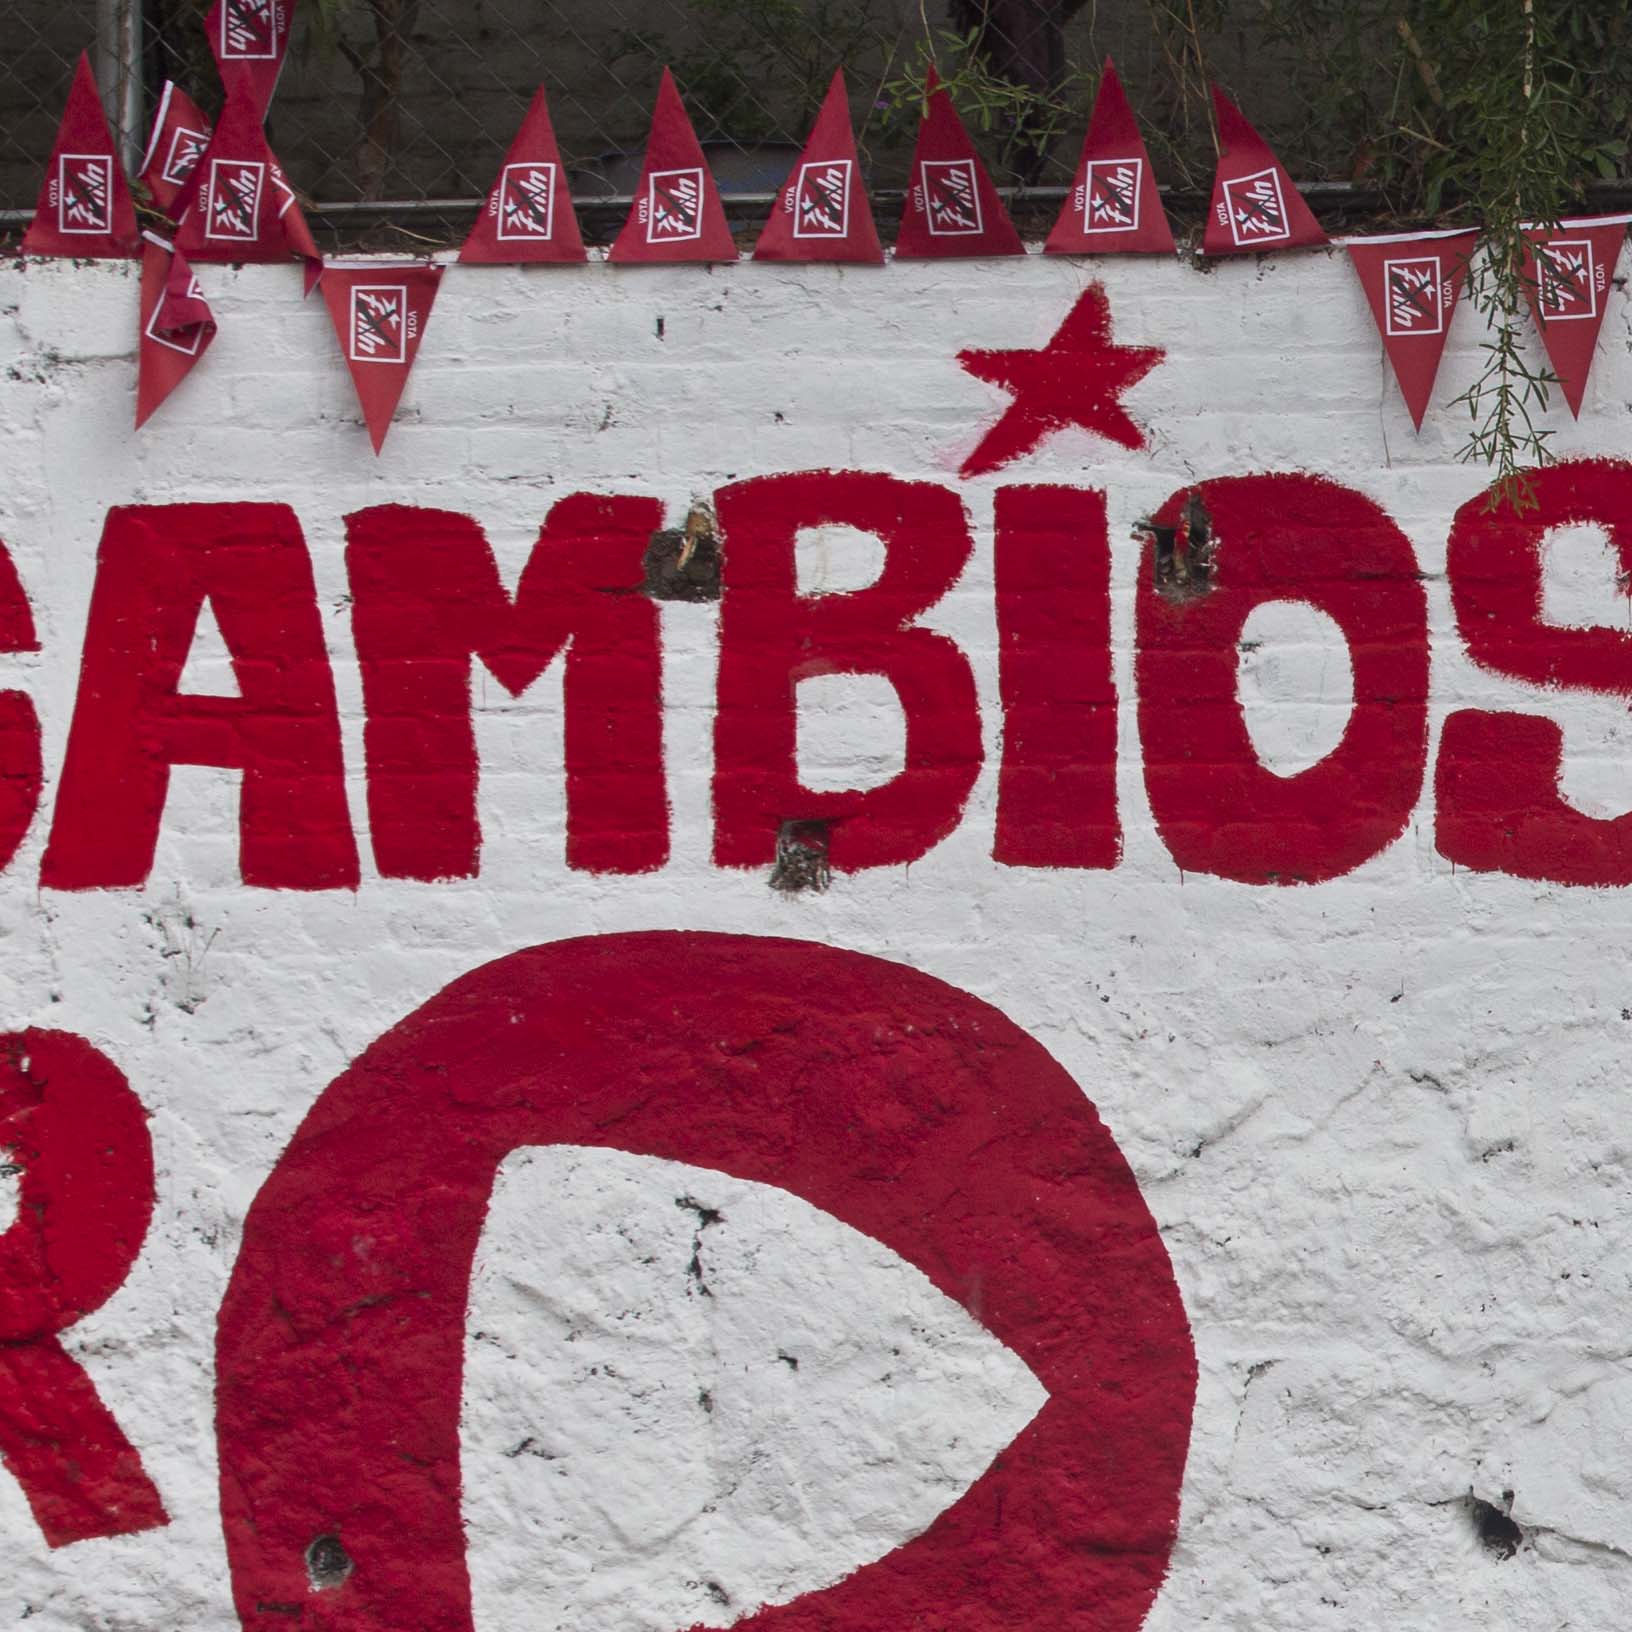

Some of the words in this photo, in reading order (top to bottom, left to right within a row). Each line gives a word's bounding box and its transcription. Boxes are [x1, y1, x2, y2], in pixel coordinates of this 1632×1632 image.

[275, 4, 286, 34] VOTA
[49, 178, 58, 208] VOTA
[199, 183, 209, 213] VOTA
[488, 189, 500, 217] VOTA
[785, 186, 797, 214] VOTA
[913, 184, 925, 213] VOTA
[1073, 184, 1085, 212] VOTA
[638, 197, 649, 224] VOTA
[1216, 201, 1228, 226] VOTA
[1594, 263, 1606, 292] VOTA
[1442, 279, 1453, 308] VOTA
[407, 310, 418, 339] VOTA
